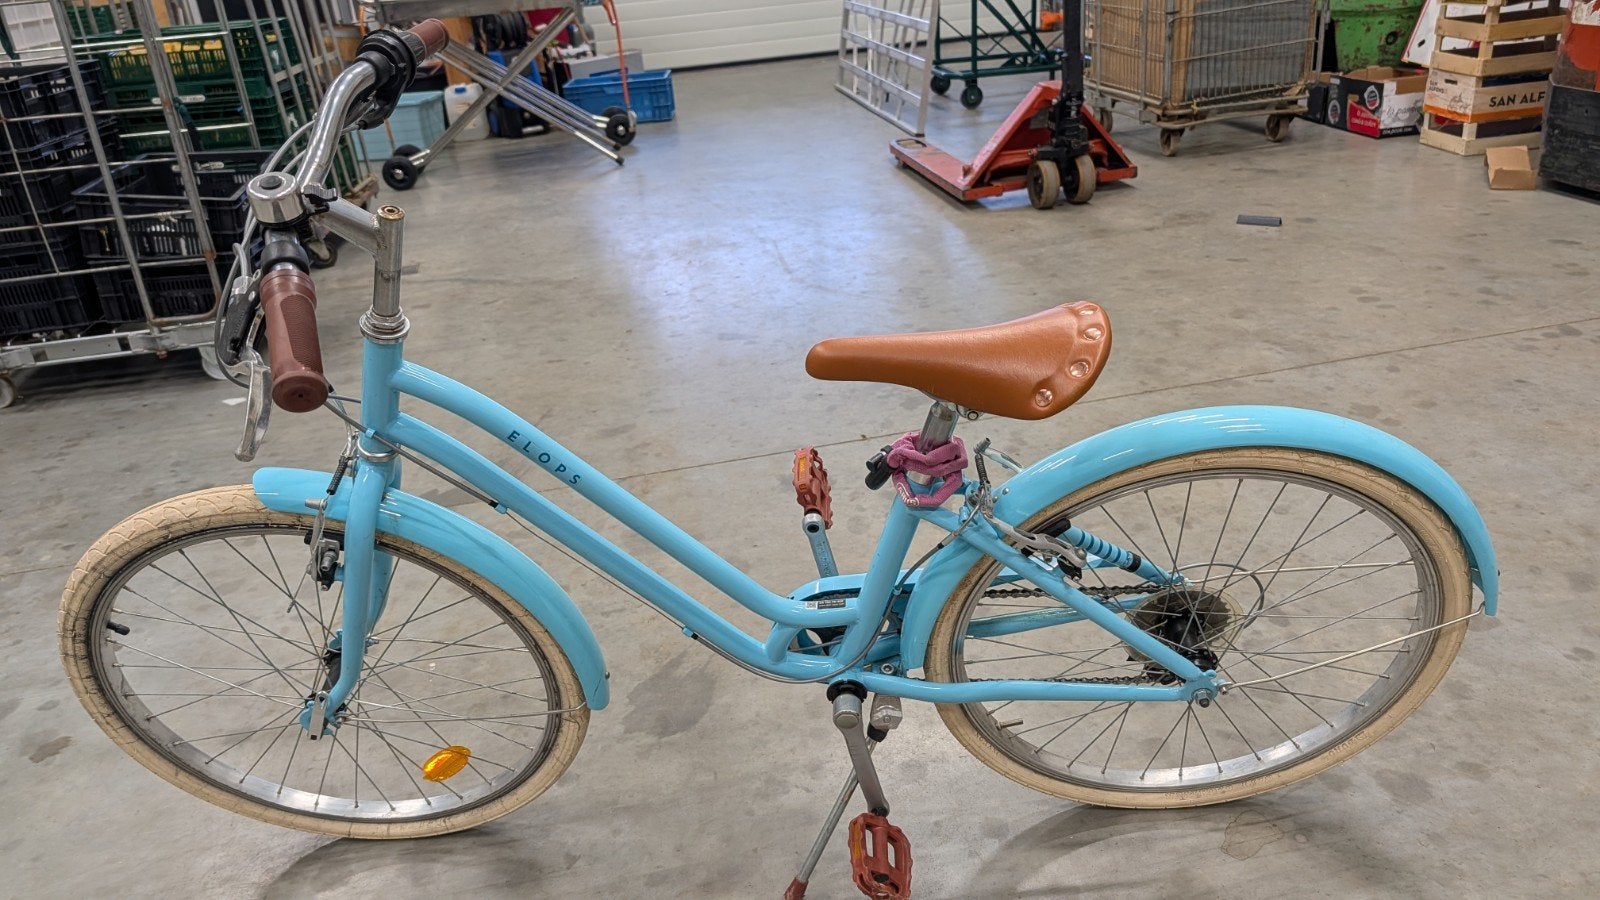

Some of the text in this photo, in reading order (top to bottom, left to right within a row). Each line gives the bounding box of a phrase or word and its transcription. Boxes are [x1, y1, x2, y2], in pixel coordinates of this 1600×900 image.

[1489, 91, 1546, 108] SAN ALF
[507, 430, 581, 485] ELOPS
